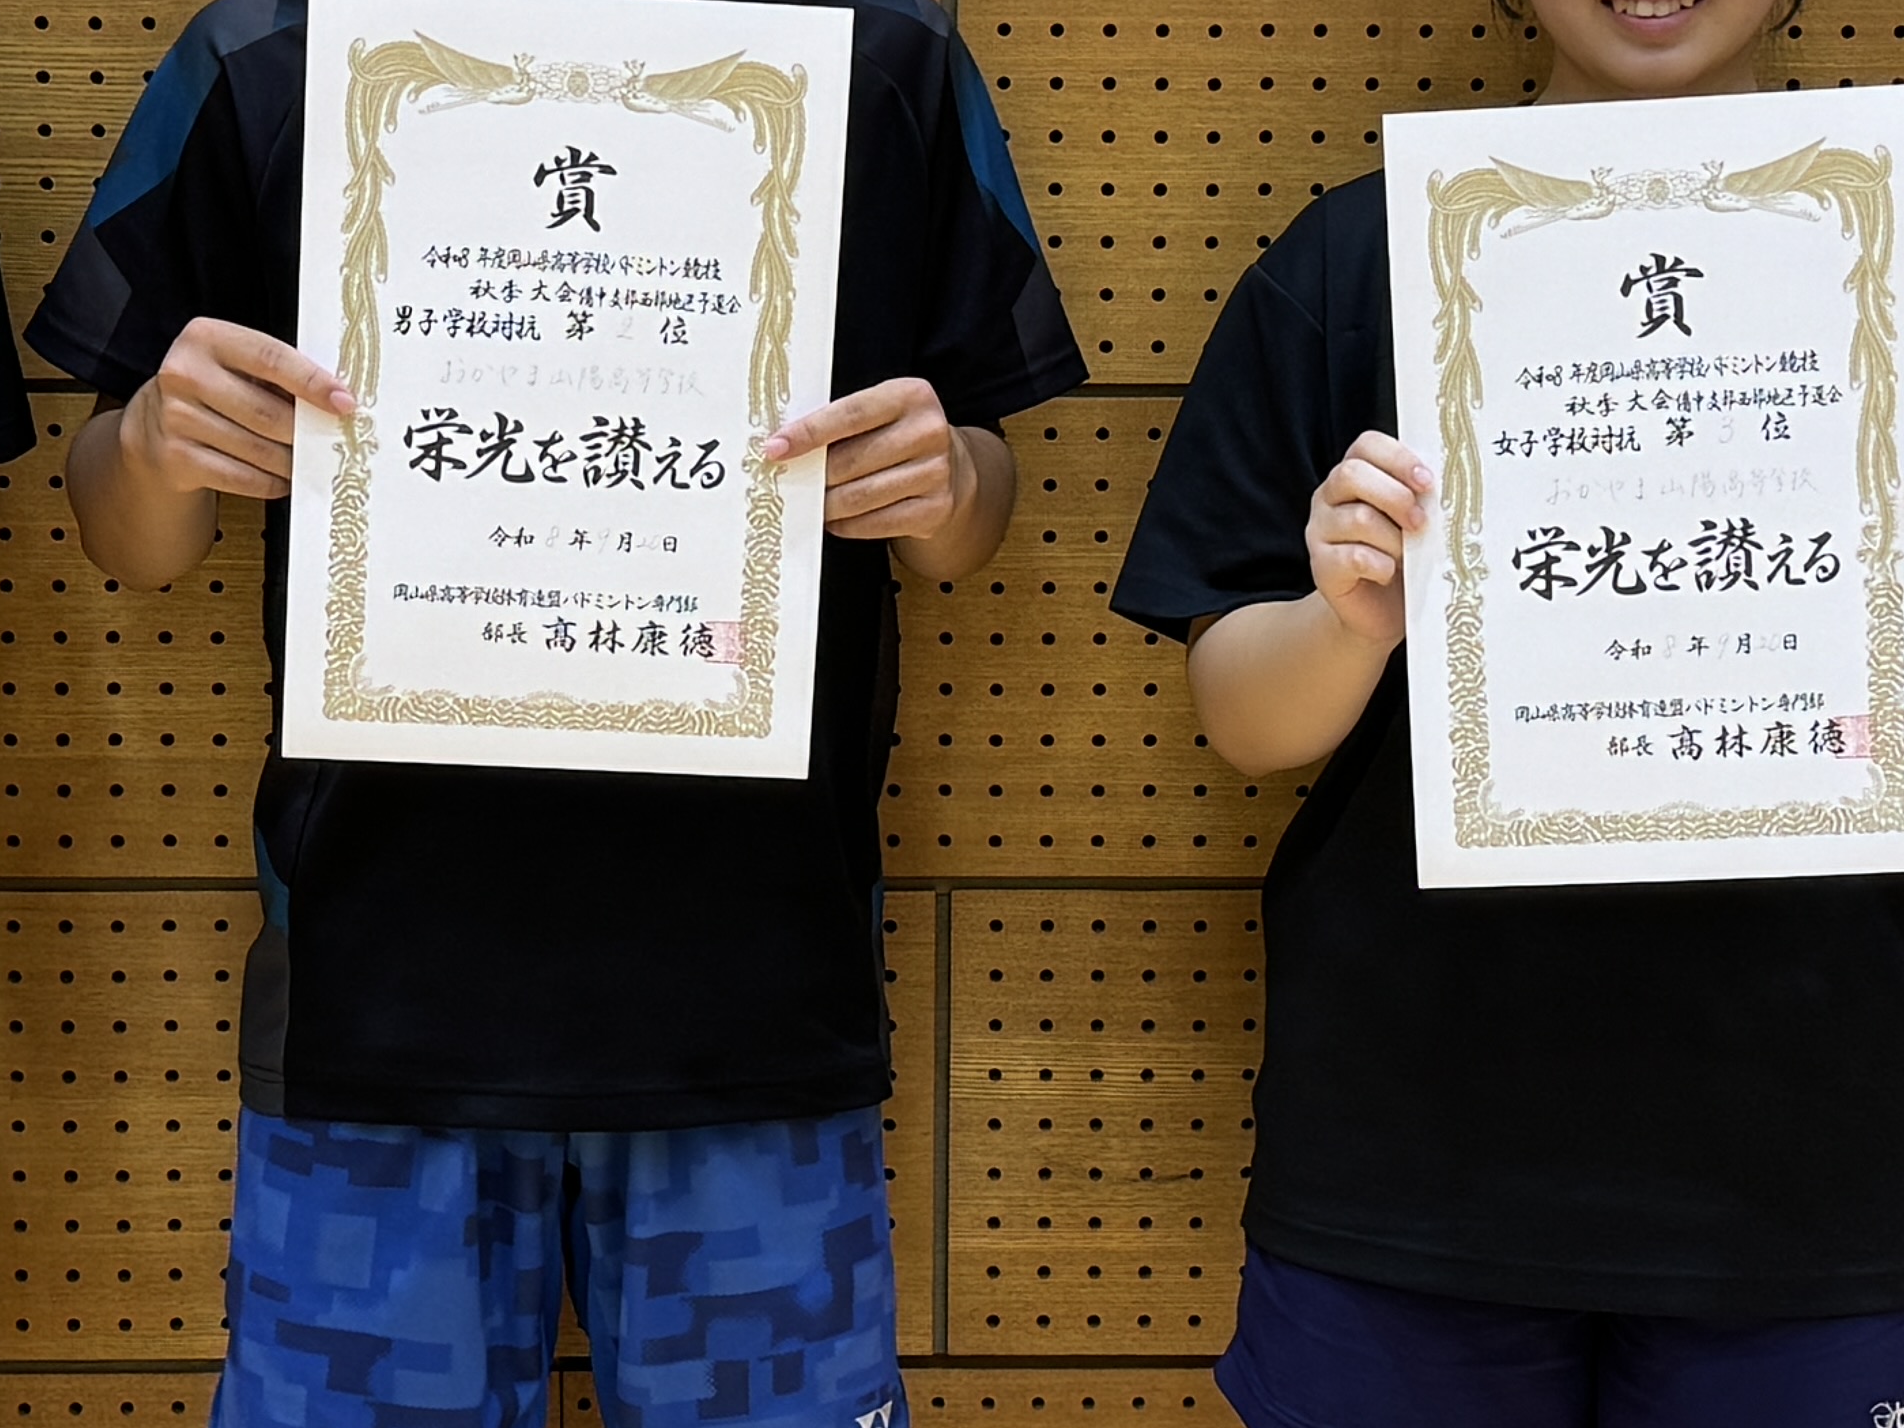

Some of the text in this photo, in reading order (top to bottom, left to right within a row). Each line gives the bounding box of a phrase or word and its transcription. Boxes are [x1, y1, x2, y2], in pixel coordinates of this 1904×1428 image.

[533, 145, 617, 231] 賞
[392, 306, 541, 341] 男子学校対抗
[1620, 252, 1704, 338] 賞
[403, 407, 725, 490] 栄光を讃える
[1492, 425, 1641, 457] 女子学校対抗
[1512, 518, 1840, 601] 栄光を讃える
[482, 621, 528, 644] 部長
[1606, 734, 1653, 757] 部長
